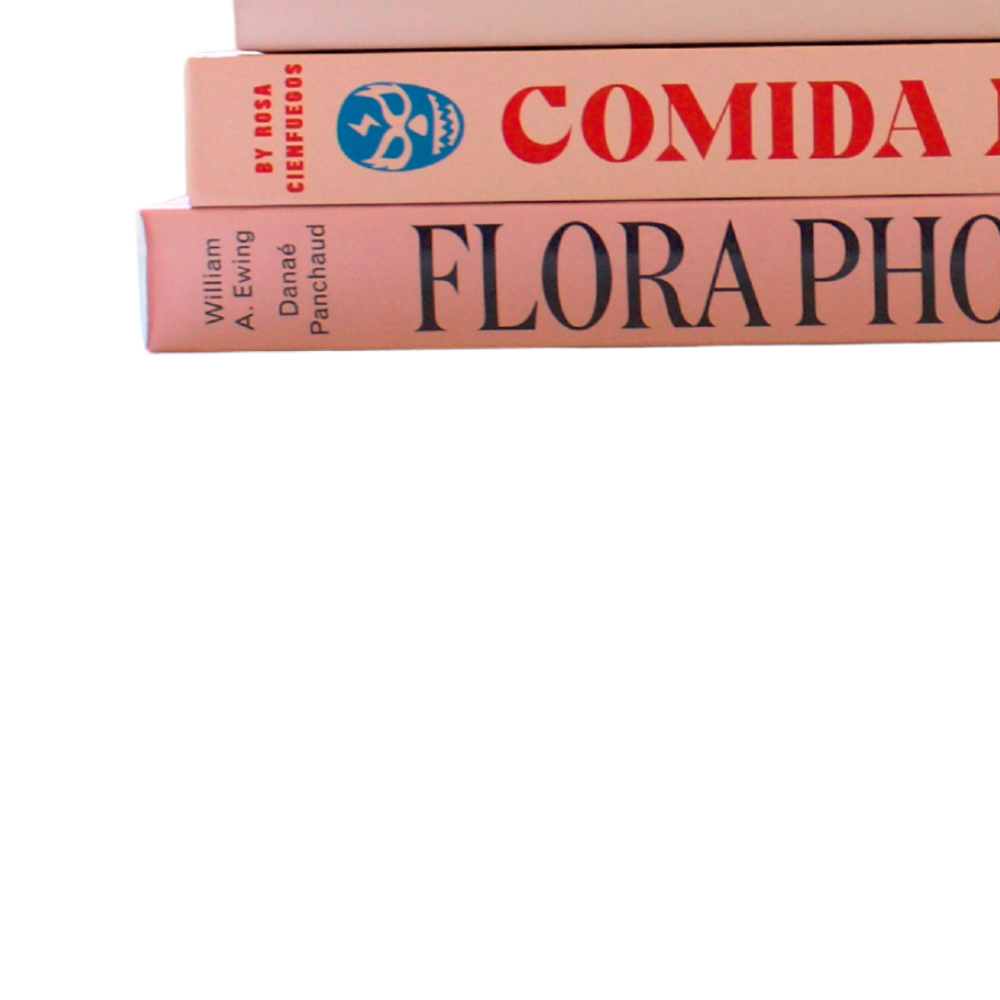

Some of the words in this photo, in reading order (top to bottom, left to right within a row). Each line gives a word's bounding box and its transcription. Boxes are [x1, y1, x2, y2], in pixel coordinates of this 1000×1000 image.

[254, 84, 272, 137] ROSA
[285, 64, 304, 193] CIENFUEGOS
[501, 80, 951, 164] COMIDA
[255, 147, 273, 173] BY
[202, 238, 224, 325] William
[232, 230, 255, 298] Ewing
[277, 243, 300, 317] Danaé
[306, 224, 330, 336] Panchaud
[411, 219, 771, 331] FLORA
[235, 306, 255, 331] A.
